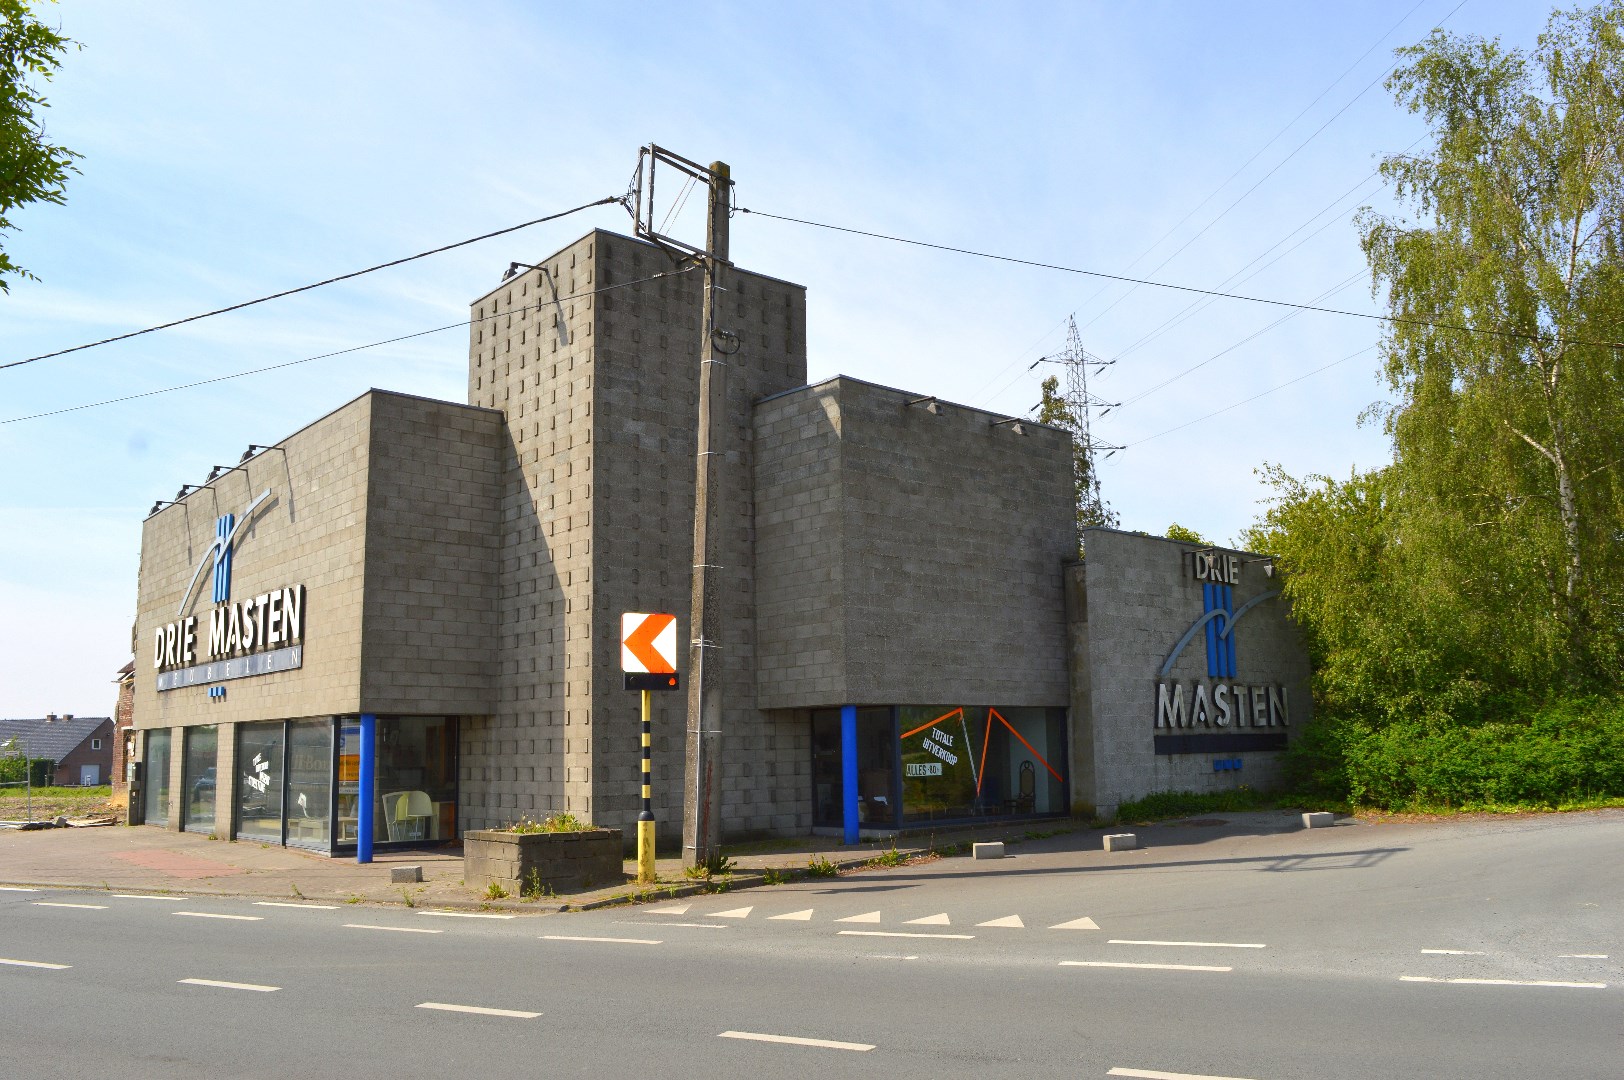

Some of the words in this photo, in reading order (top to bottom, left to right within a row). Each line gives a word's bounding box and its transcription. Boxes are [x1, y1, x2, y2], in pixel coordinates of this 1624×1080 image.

[1196, 551, 1239, 585] DRIE
[153, 616, 197, 669] DRIE
[207, 584, 304, 657] MASTEN
[159, 648, 298, 687] MEUBELEN
[1157, 683, 1290, 728] MASTEN
[922, 737, 958, 765] UITVERKOOP
[932, 727, 954, 747] TOTALE
[907, 765, 927, 776] ALLES
